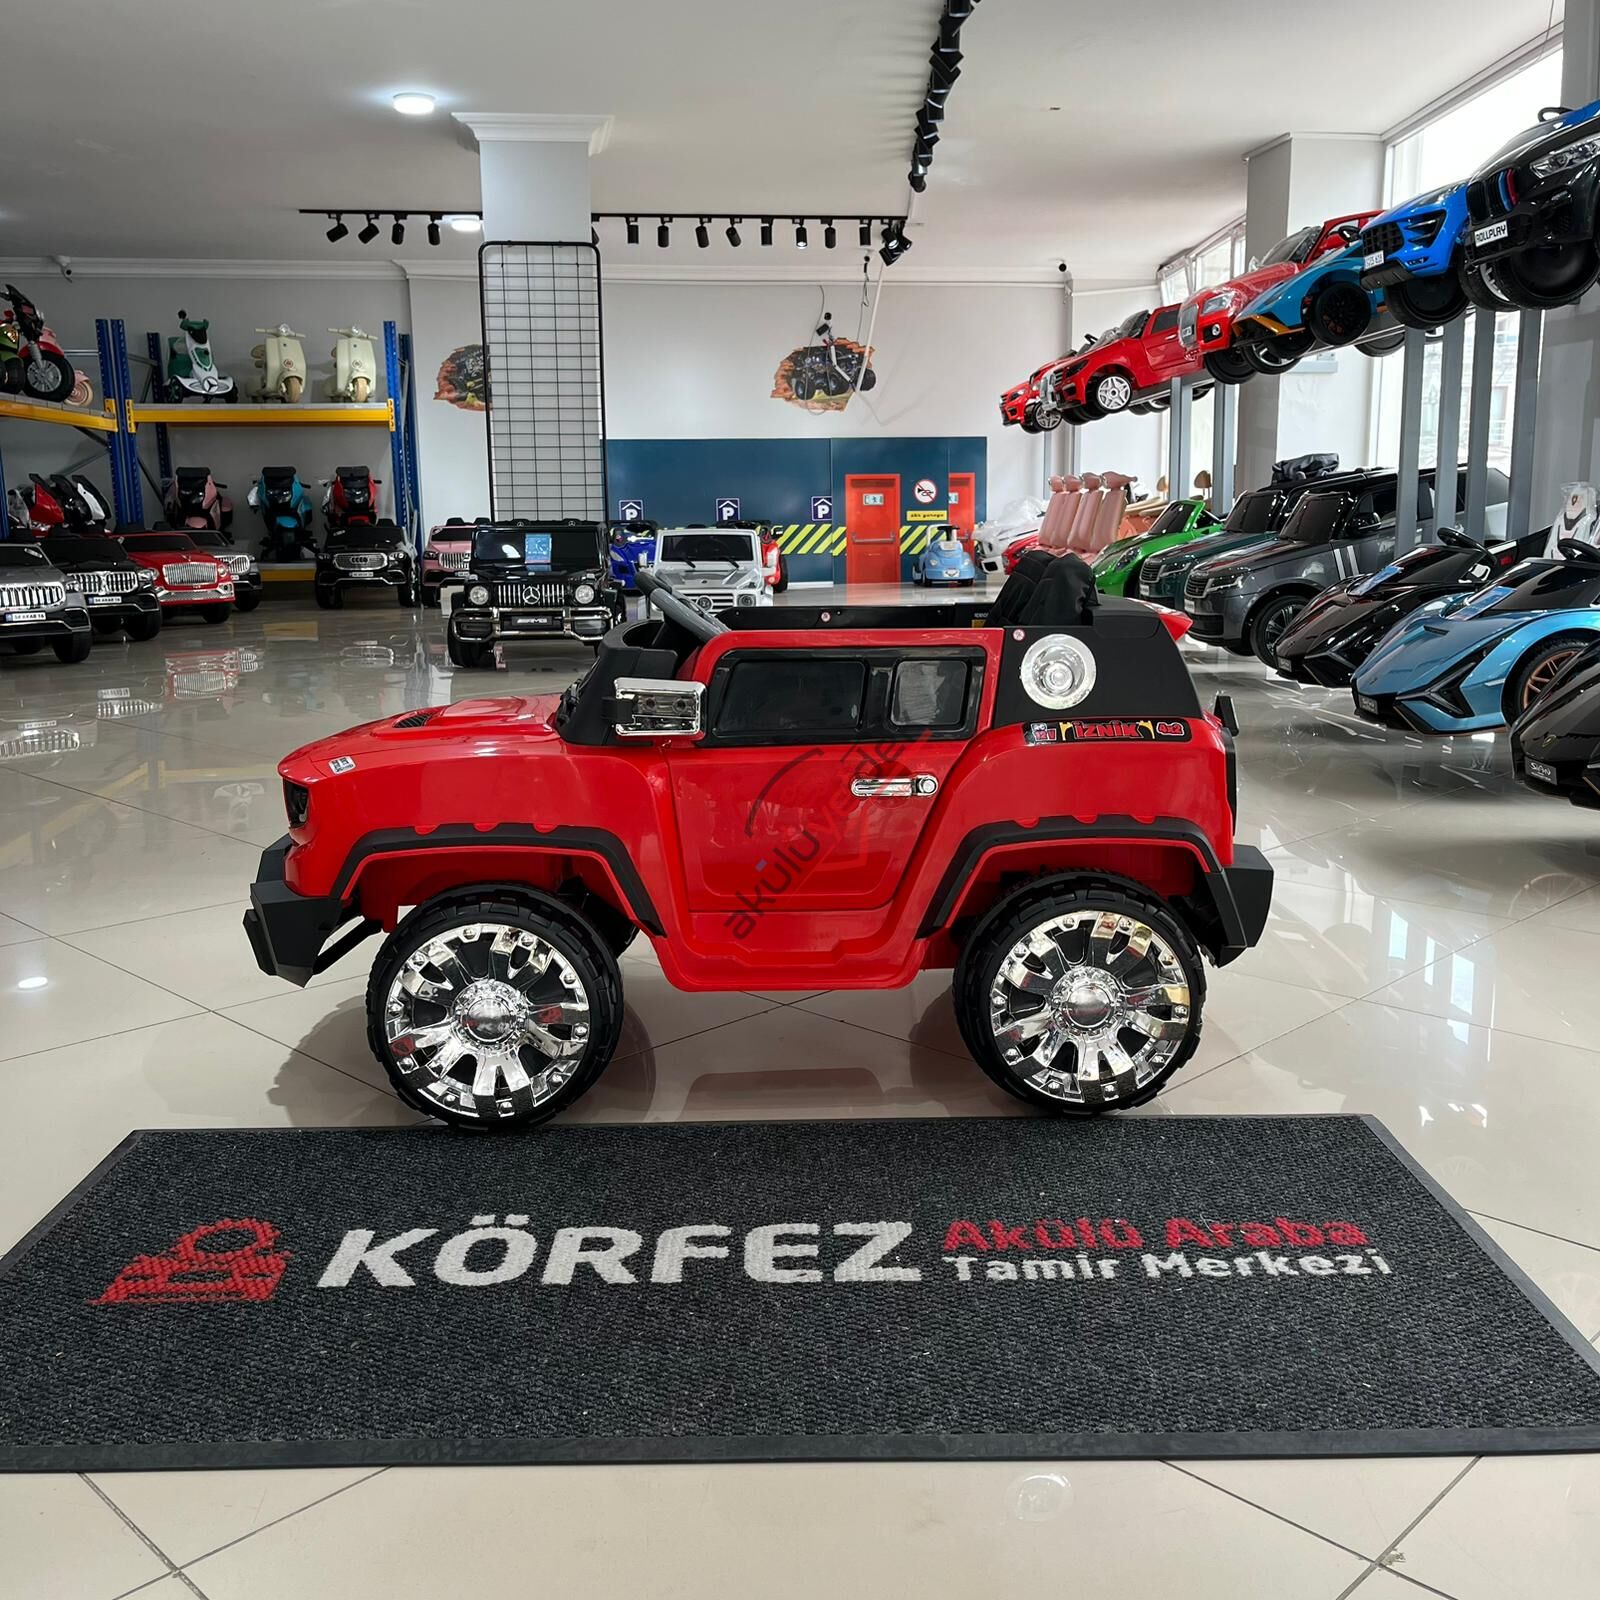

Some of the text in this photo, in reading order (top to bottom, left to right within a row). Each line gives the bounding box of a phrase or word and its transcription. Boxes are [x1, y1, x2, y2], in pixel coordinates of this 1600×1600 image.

[625, 508, 638, 521] P
[722, 507, 735, 521] P
[818, 504, 830, 519] P
[942, 1217, 1369, 1252] Akülü Araba
[317, 1214, 922, 1288] KÖRFEZ
[941, 1248, 1393, 1281] Tamir Merkezi
